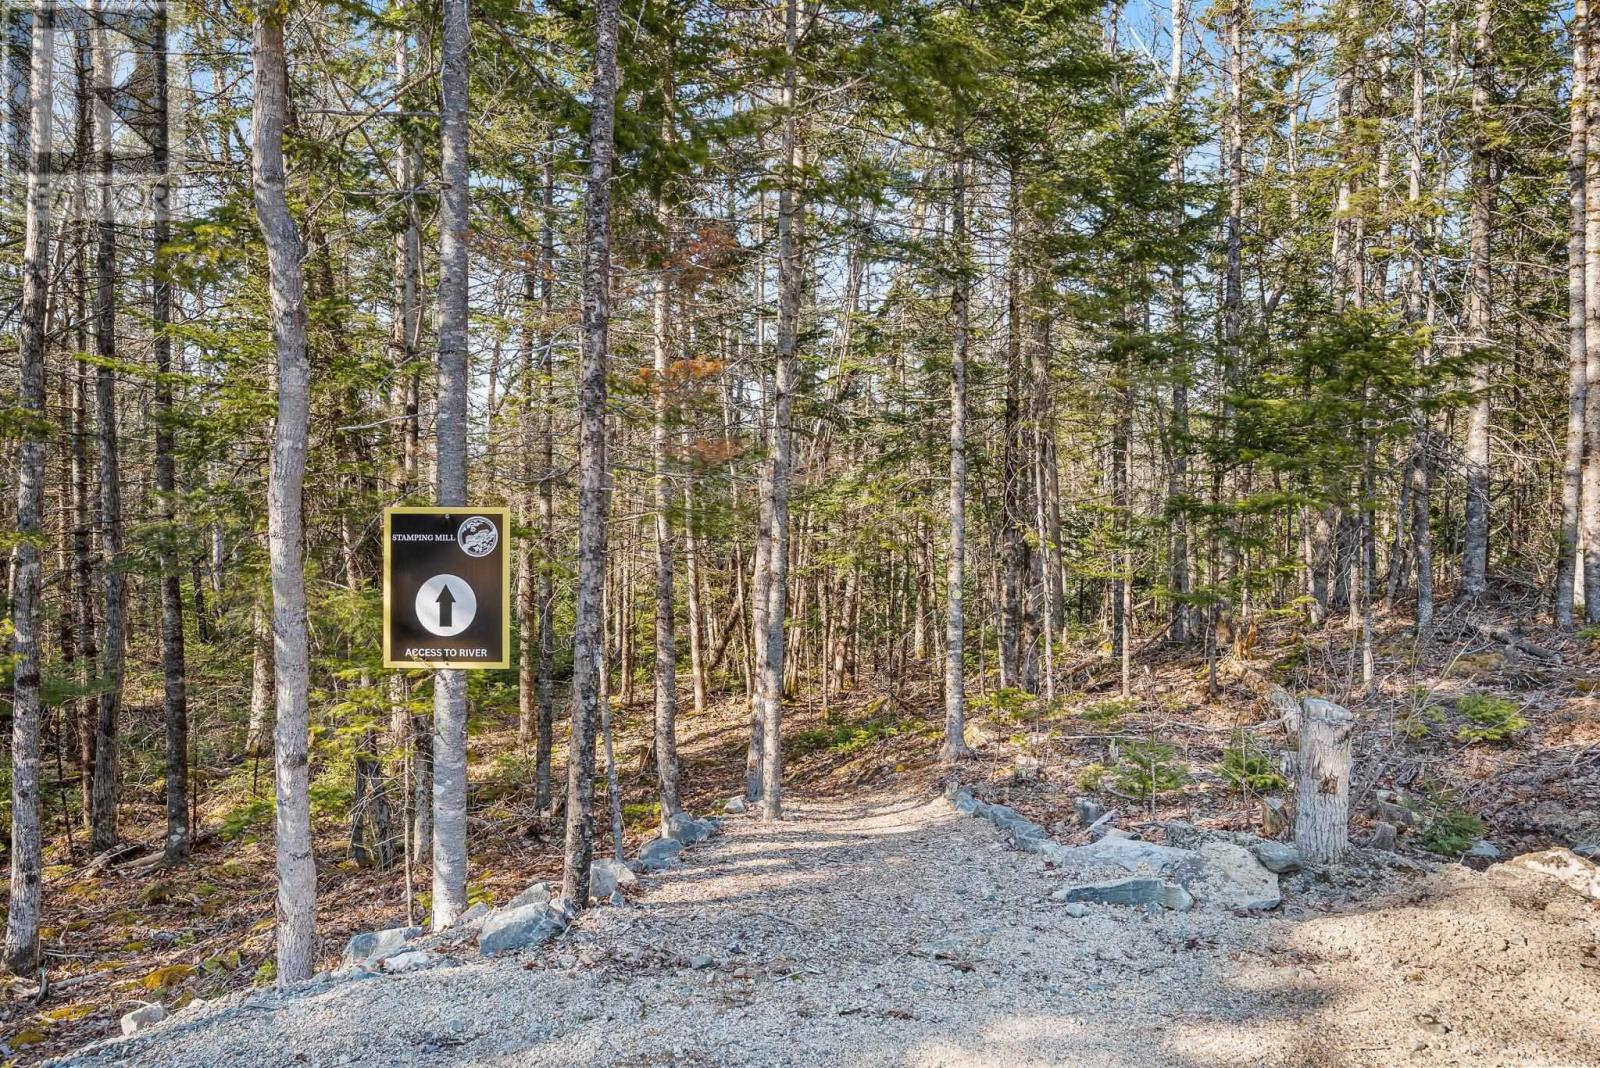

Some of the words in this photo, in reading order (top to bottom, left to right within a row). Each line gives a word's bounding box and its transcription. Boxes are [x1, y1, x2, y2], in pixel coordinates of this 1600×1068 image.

[405, 648, 442, 657] ACCESS
[444, 648, 457, 657] TO
[460, 648, 487, 657] RIVER
